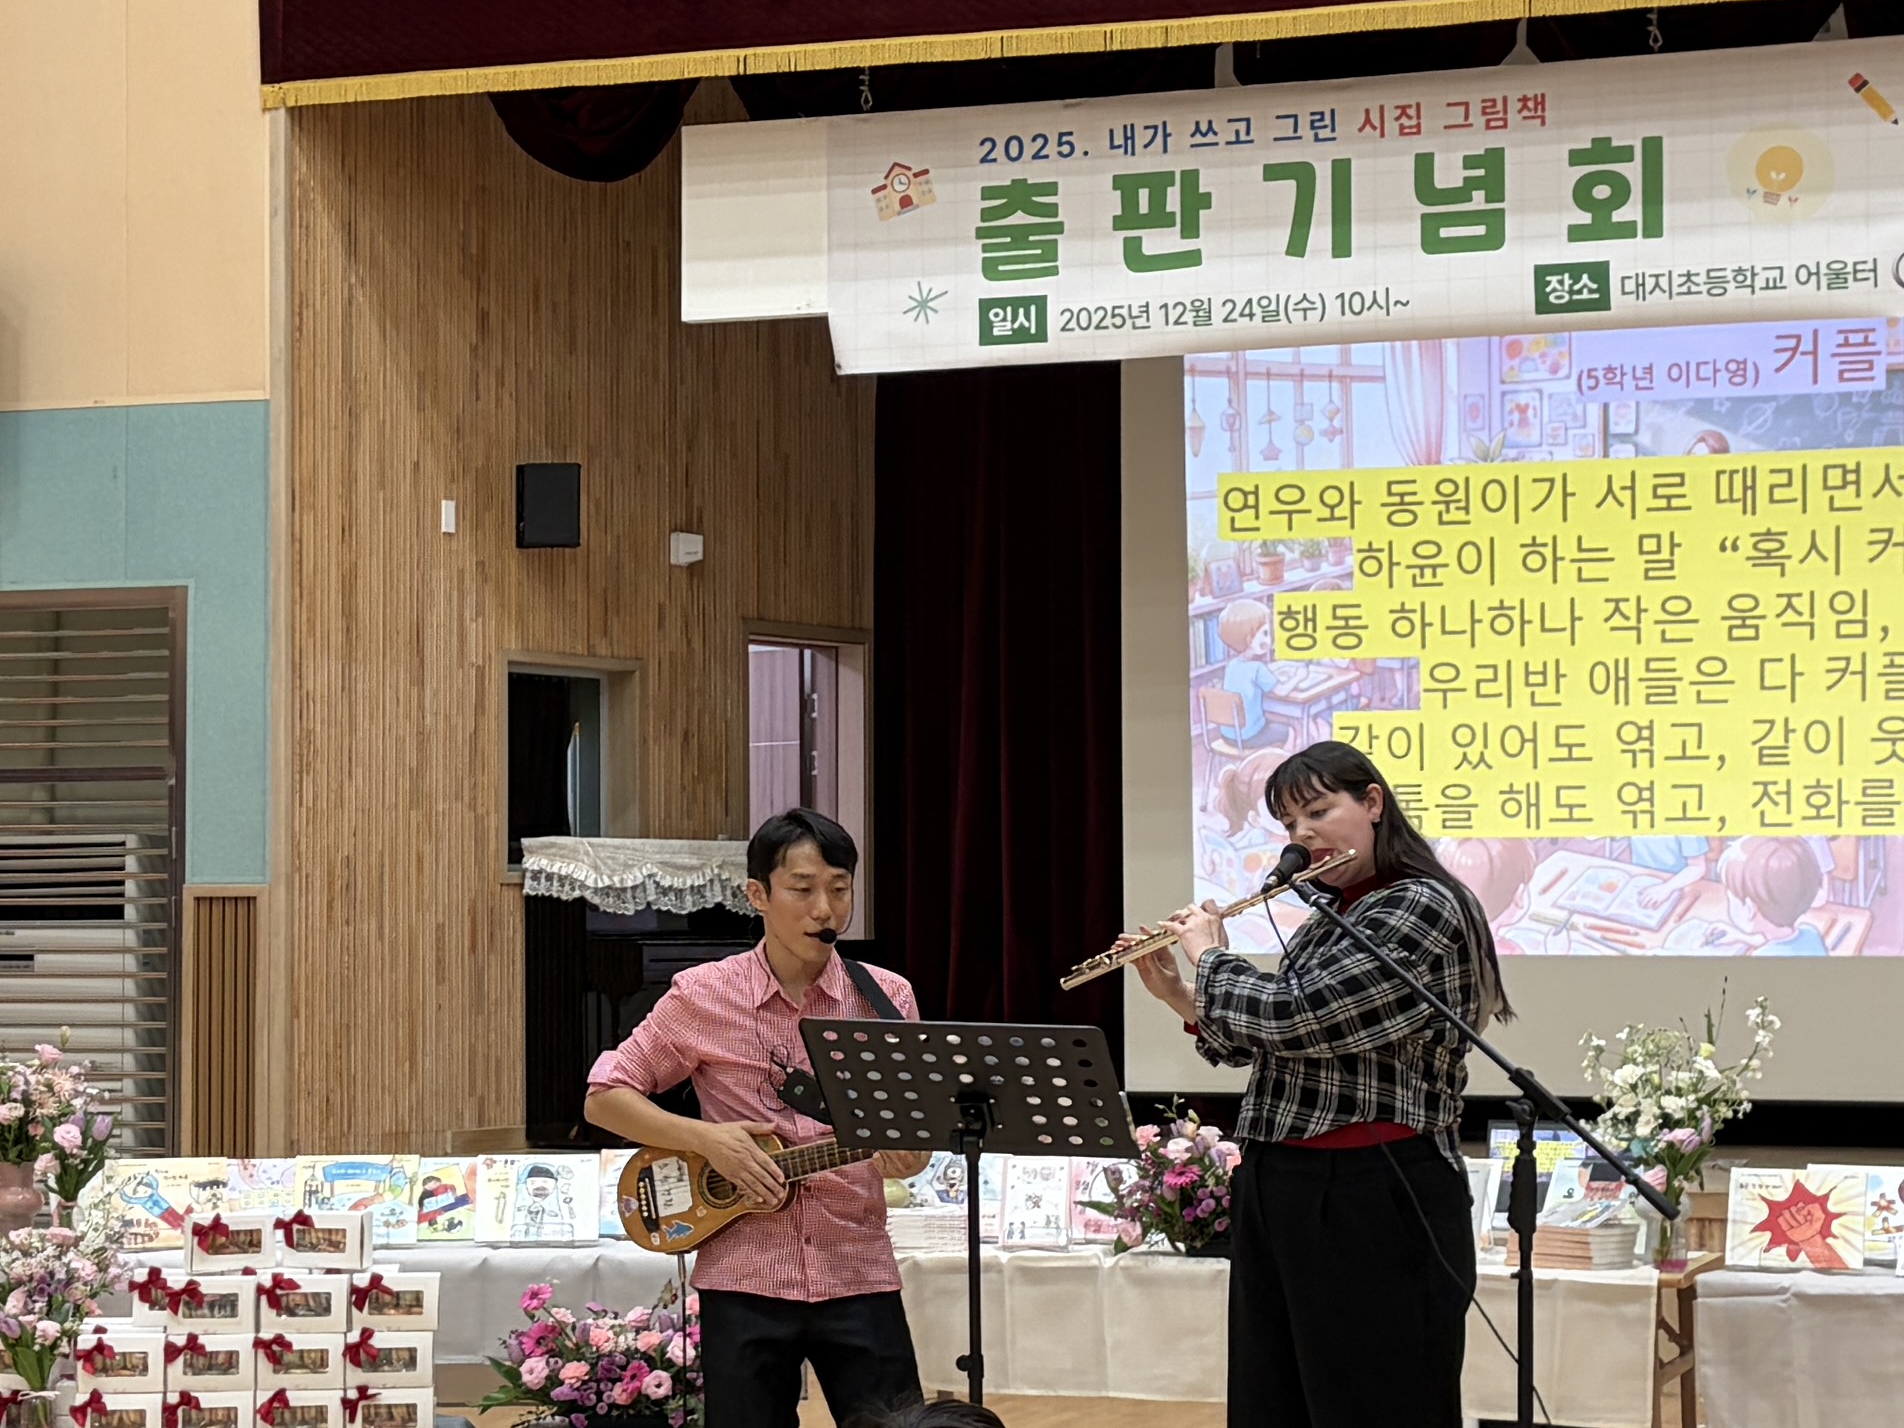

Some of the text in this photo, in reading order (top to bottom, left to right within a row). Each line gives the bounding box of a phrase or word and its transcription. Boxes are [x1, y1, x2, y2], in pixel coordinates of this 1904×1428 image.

[979, 93, 1546, 163] 2025. 내가 쓰고 그린 시집 그림책
[1546, 258, 1878, 303] 장소 대지초등학교 어울터
[989, 287, 1409, 335] 일시 2025년 12월 24일(수) 10시~
[1577, 327, 1883, 396] (5학년 이다영) 커플
[1224, 481, 1362, 532] 연우와
[1380, 473, 1576, 527] 동원이가
[1596, 470, 1692, 520] 서로
[1357, 537, 1495, 589] 하윤이
[1520, 535, 1615, 584] 하는
[1638, 531, 1682, 580] 말
[1719, 525, 1840, 577] “혹시
[1277, 604, 1368, 651] 행동
[1389, 597, 1583, 649] 하나하나
[1604, 595, 1699, 644] 작은
[1721, 589, 1889, 642] 움직임,
[1423, 658, 1567, 709] 우리반
[1589, 656, 1735, 706] 애들은
[1760, 653, 1804, 703] 다
[1452, 721, 1593, 770] 있어도
[1616, 719, 1726, 771] 엮고,
[1752, 716, 1843, 766] 같이
[1499, 781, 1593, 830] 해도
[1617, 780, 1726, 832] 엮고,
[1752, 778, 1901, 828] 전화를
